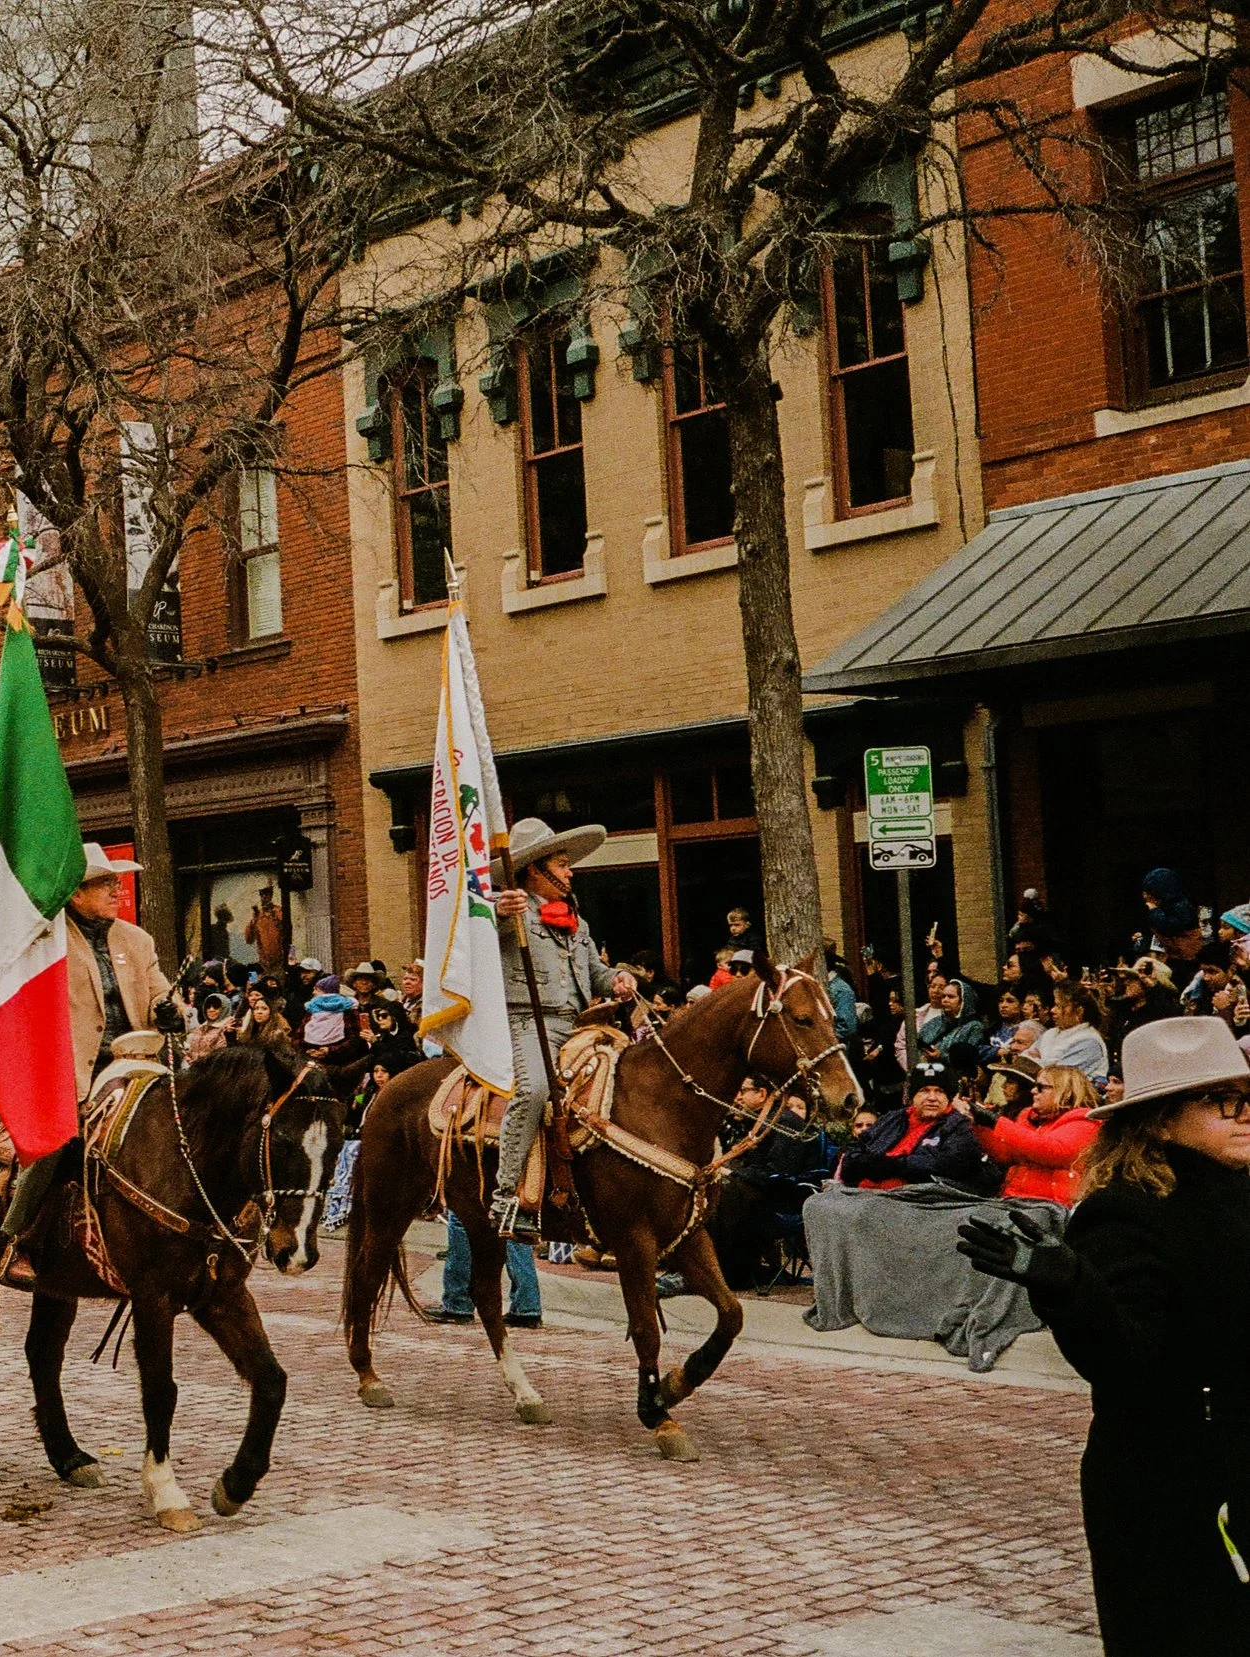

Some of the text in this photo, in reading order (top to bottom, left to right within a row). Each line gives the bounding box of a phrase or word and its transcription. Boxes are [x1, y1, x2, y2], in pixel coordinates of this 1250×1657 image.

[149, 632, 180, 644] SEUM
[37, 658, 74, 668] USEUM
[53, 704, 110, 740] EUM
[870, 755, 880, 766] 5
[877, 767, 920, 777] PASSENGER
[883, 776, 915, 786] LOADING
[888, 785, 910, 794] ONLY
[441, 848, 460, 873] DE
